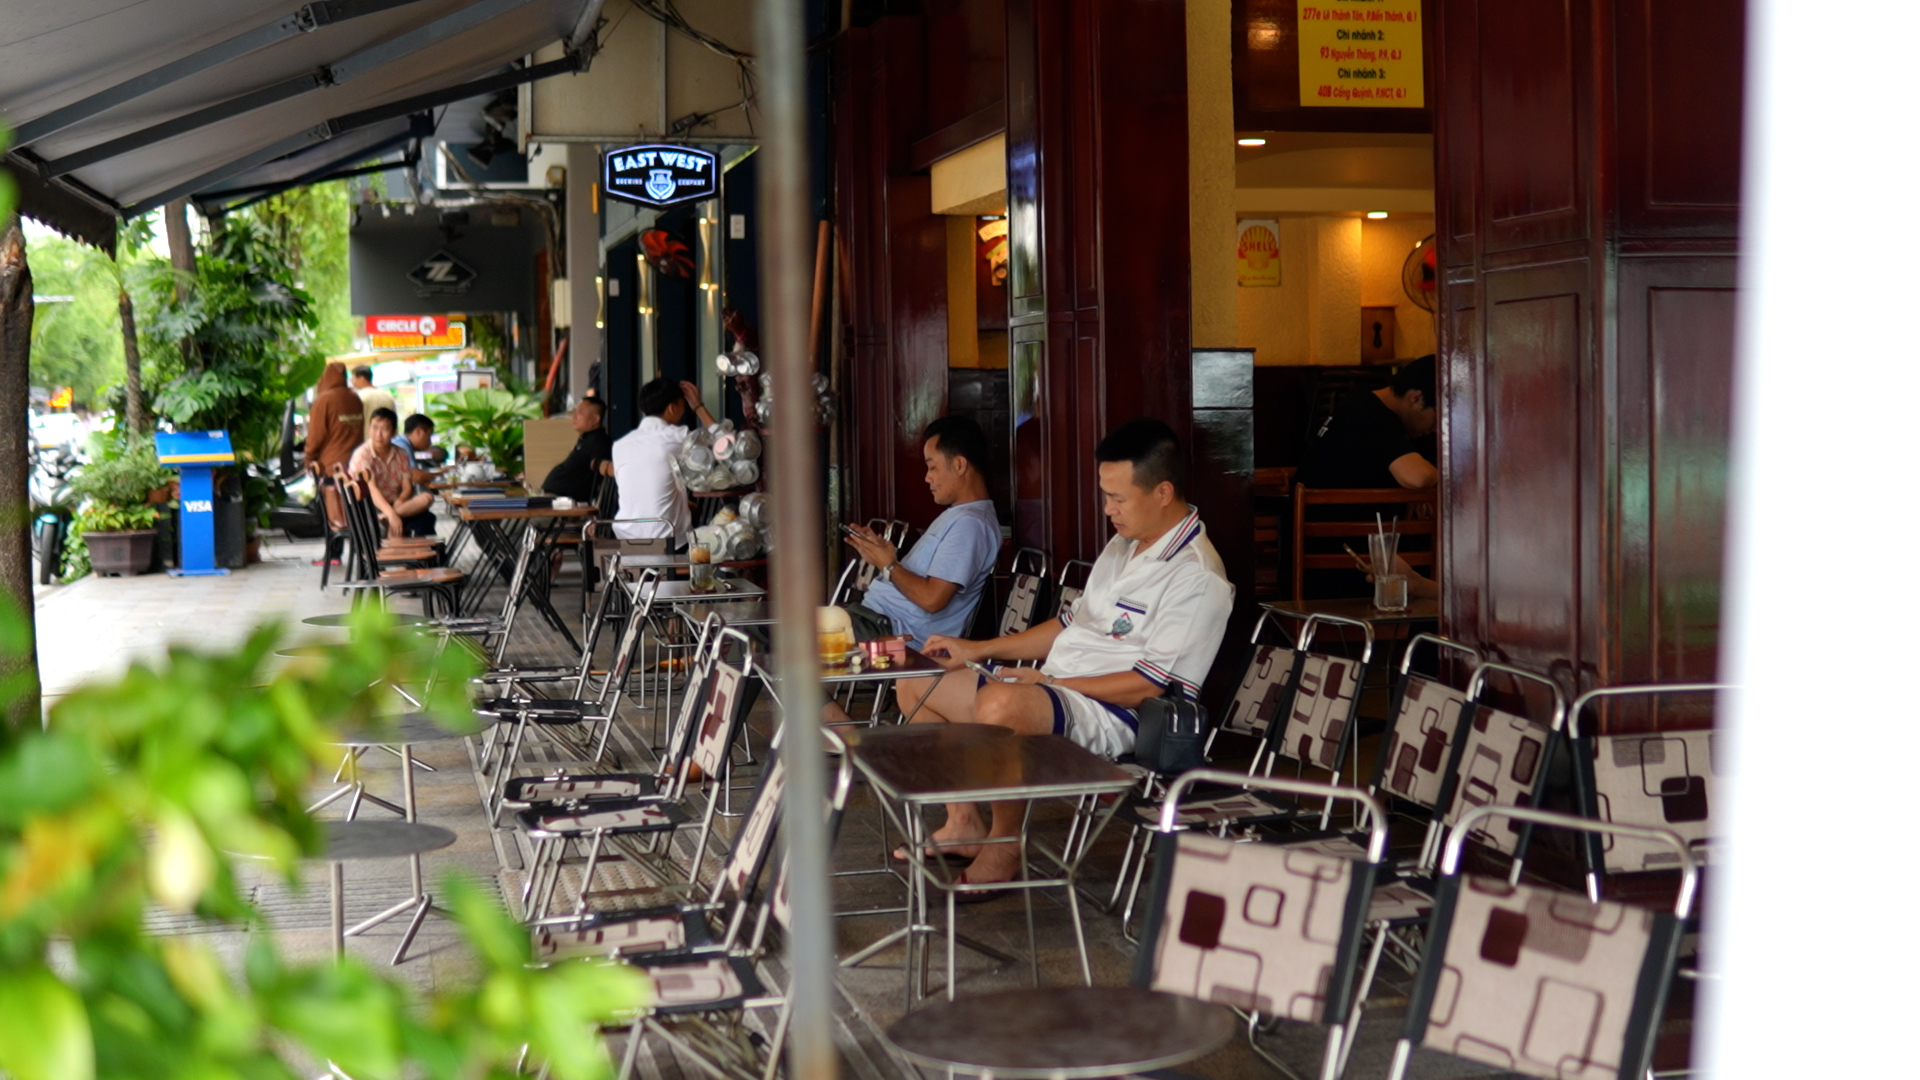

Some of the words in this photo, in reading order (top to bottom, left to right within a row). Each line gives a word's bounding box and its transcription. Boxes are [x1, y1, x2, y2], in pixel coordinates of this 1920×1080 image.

[1336, 29, 1350, 40] Chi
[1351, 29, 1376, 40] nhánh
[1377, 30, 1385, 41] 2:
[1320, 46, 1330, 59] 93
[1337, 67, 1351, 79] Chi
[1352, 67, 1377, 79] nhánh
[1378, 68, 1386, 79] 3:
[1333, 84, 1351, 101] Cống
[613, 152, 658, 172] EAST
[659, 151, 707, 172] WEST
[678, 178, 706, 187] COMPANY
[1243, 241, 1273, 252] SHELL
[376, 319, 418, 332] CIRCLE
[183, 500, 213, 512] VISA
